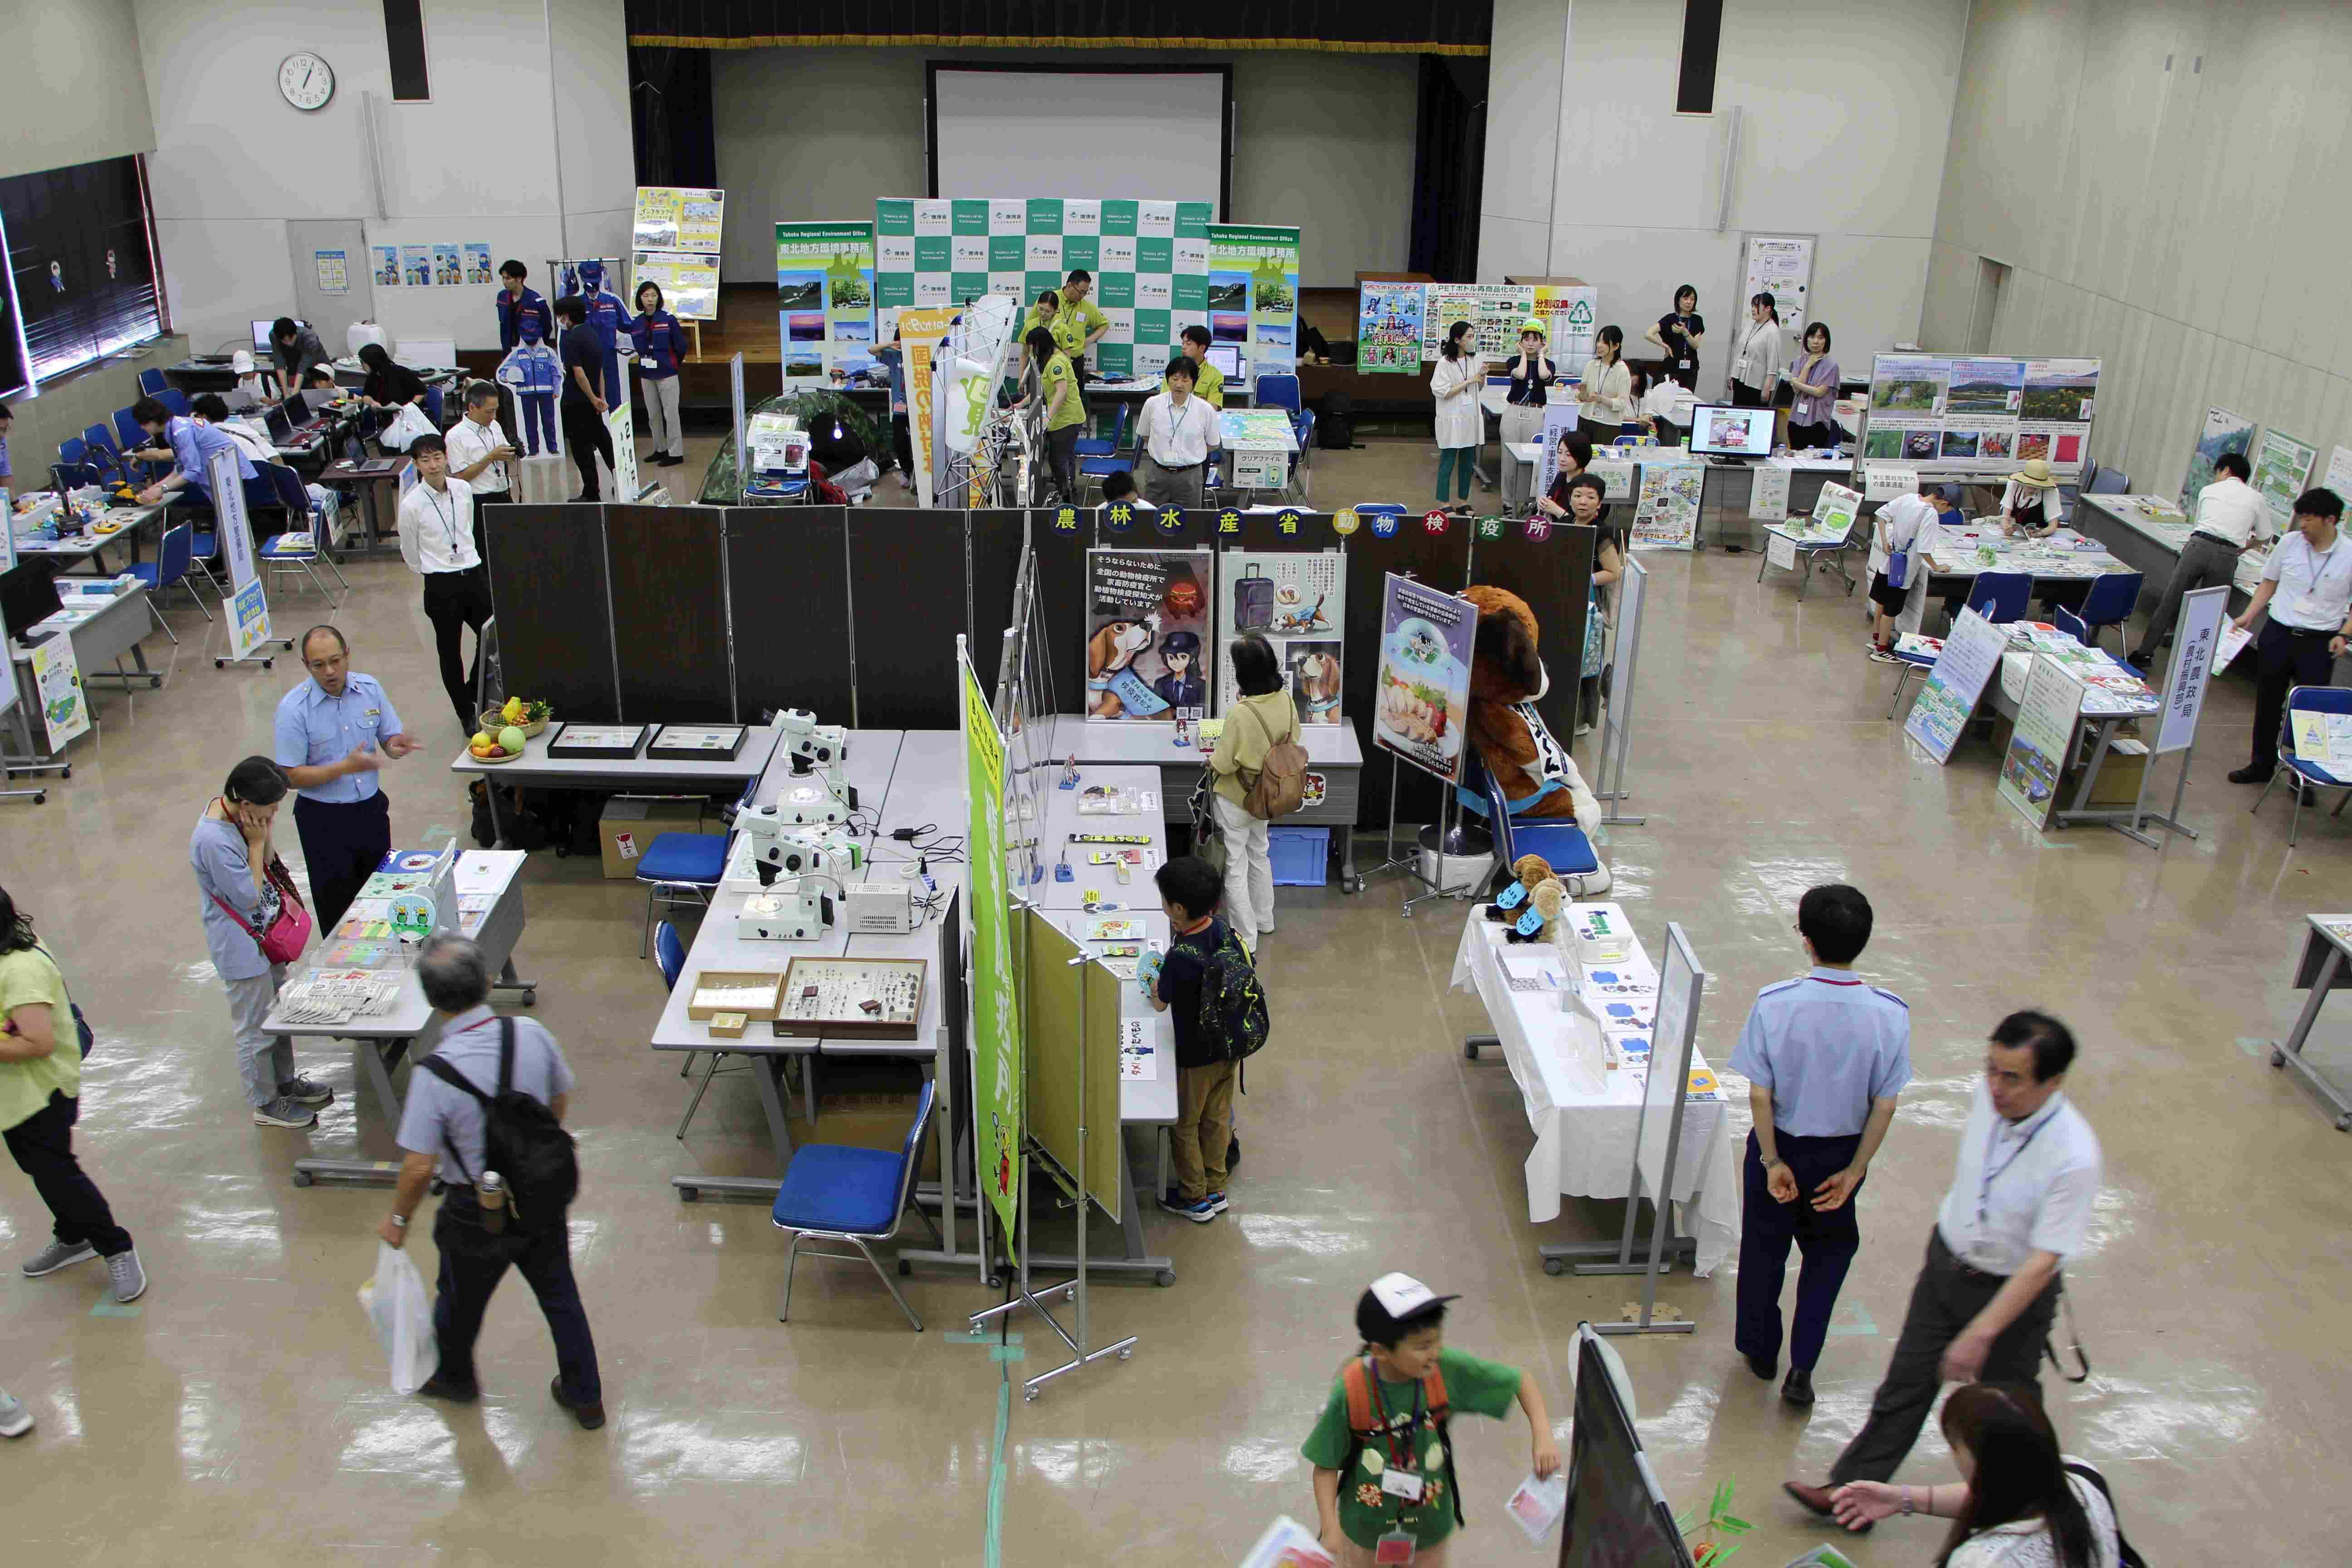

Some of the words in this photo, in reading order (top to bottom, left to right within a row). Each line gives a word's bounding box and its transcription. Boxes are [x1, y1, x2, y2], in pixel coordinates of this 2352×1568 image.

[780, 243, 869, 254] 東北地方環境事務所
[1210, 245, 1295, 258] 東北地方環境事務所
[1438, 285, 1532, 294] PETボトル再商品化の流れ
[1535, 299, 1573, 309] 分別収集に
[1055, 505, 1301, 534] 農林水産省
[1336, 512, 1547, 537] 動物検疫所
[1096, 568, 1165, 583] 全国の動物検疫所で
[1107, 578, 1152, 591] 家畜防疫官と
[1094, 585, 1162, 601] 動植物検疫探知犬が
[1099, 595, 1155, 609] 活動しています。
[2182, 628, 2210, 718] 東北農政局
